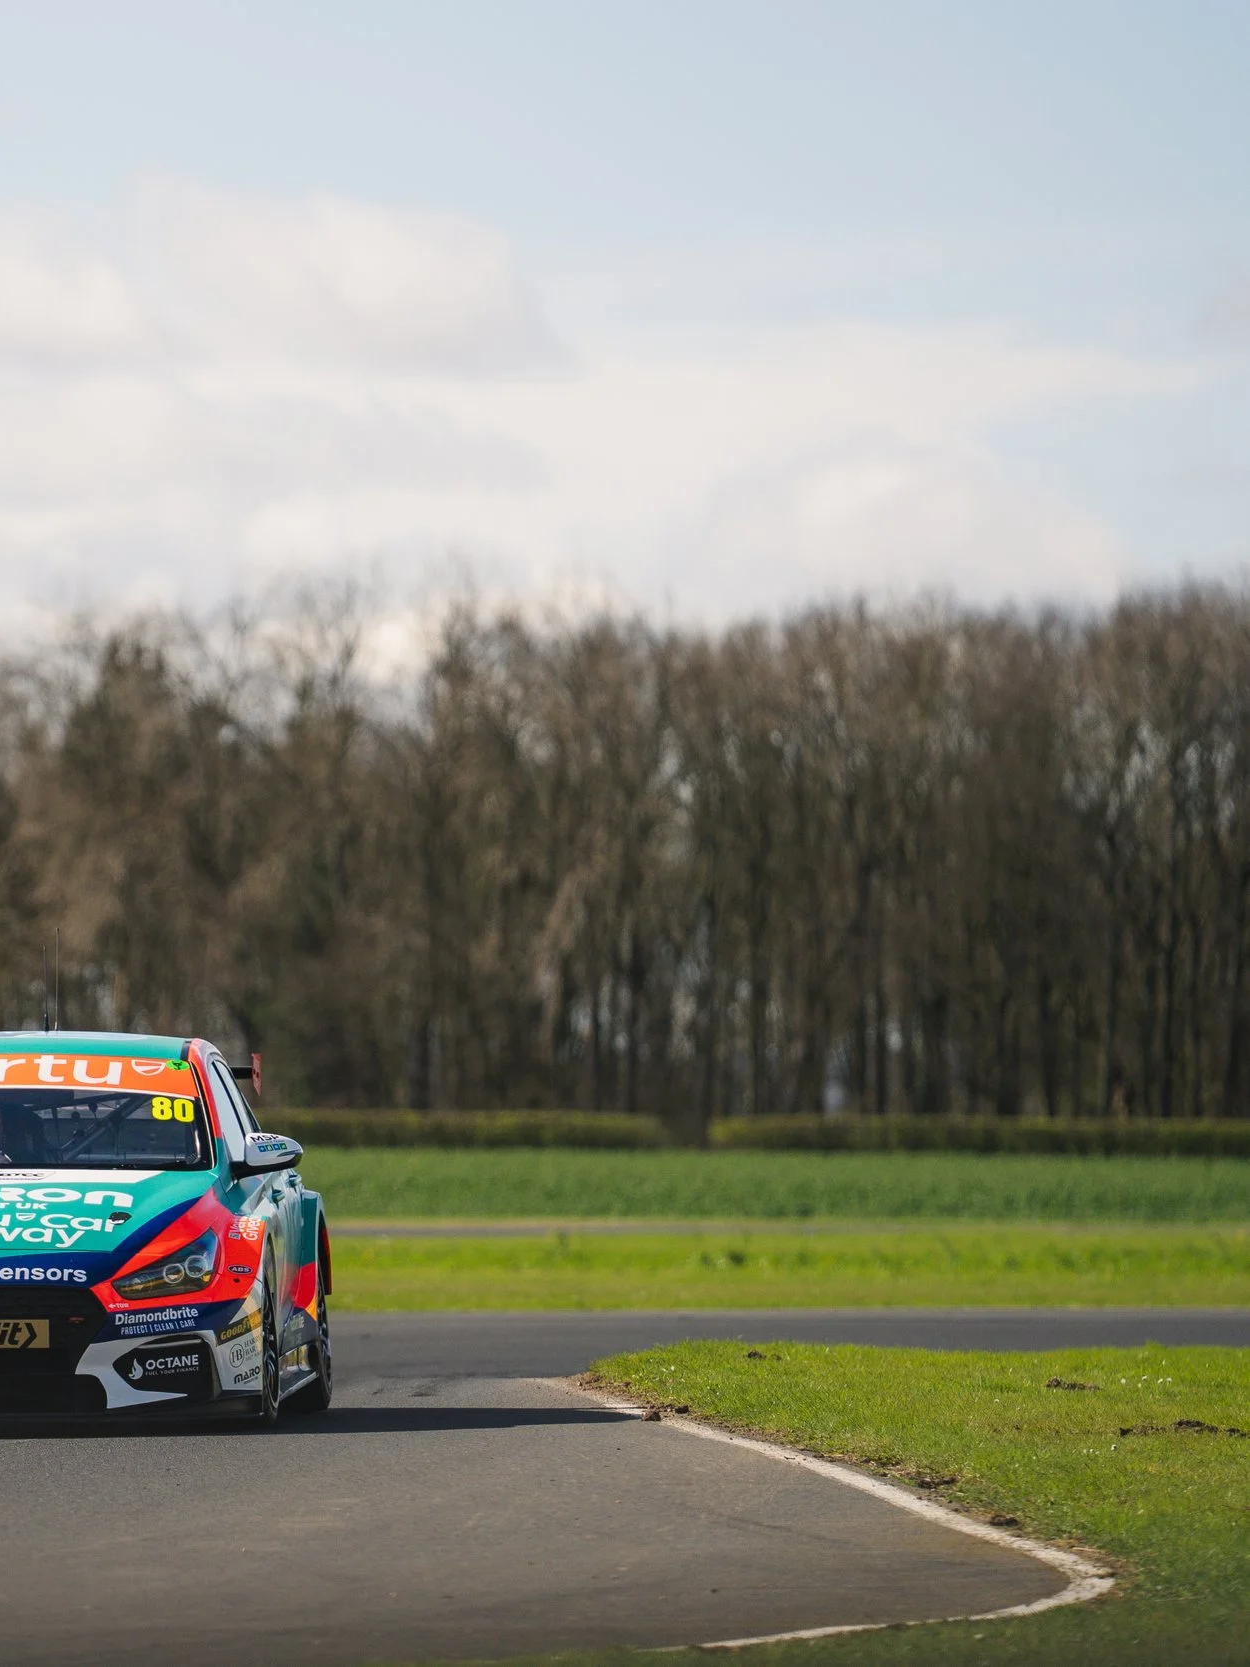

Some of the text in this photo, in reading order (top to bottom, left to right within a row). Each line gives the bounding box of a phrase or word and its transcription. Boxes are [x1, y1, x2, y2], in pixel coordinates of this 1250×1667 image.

[151, 1096, 195, 1123] 80
[15, 1202, 49, 1210] UK
[40, 1213, 124, 1233] Car
[115, 1307, 199, 1325] Diamondbrite
[121, 1319, 196, 1335] PROTECT CLEAN CARE
[145, 1354, 199, 1370] OCTANE
